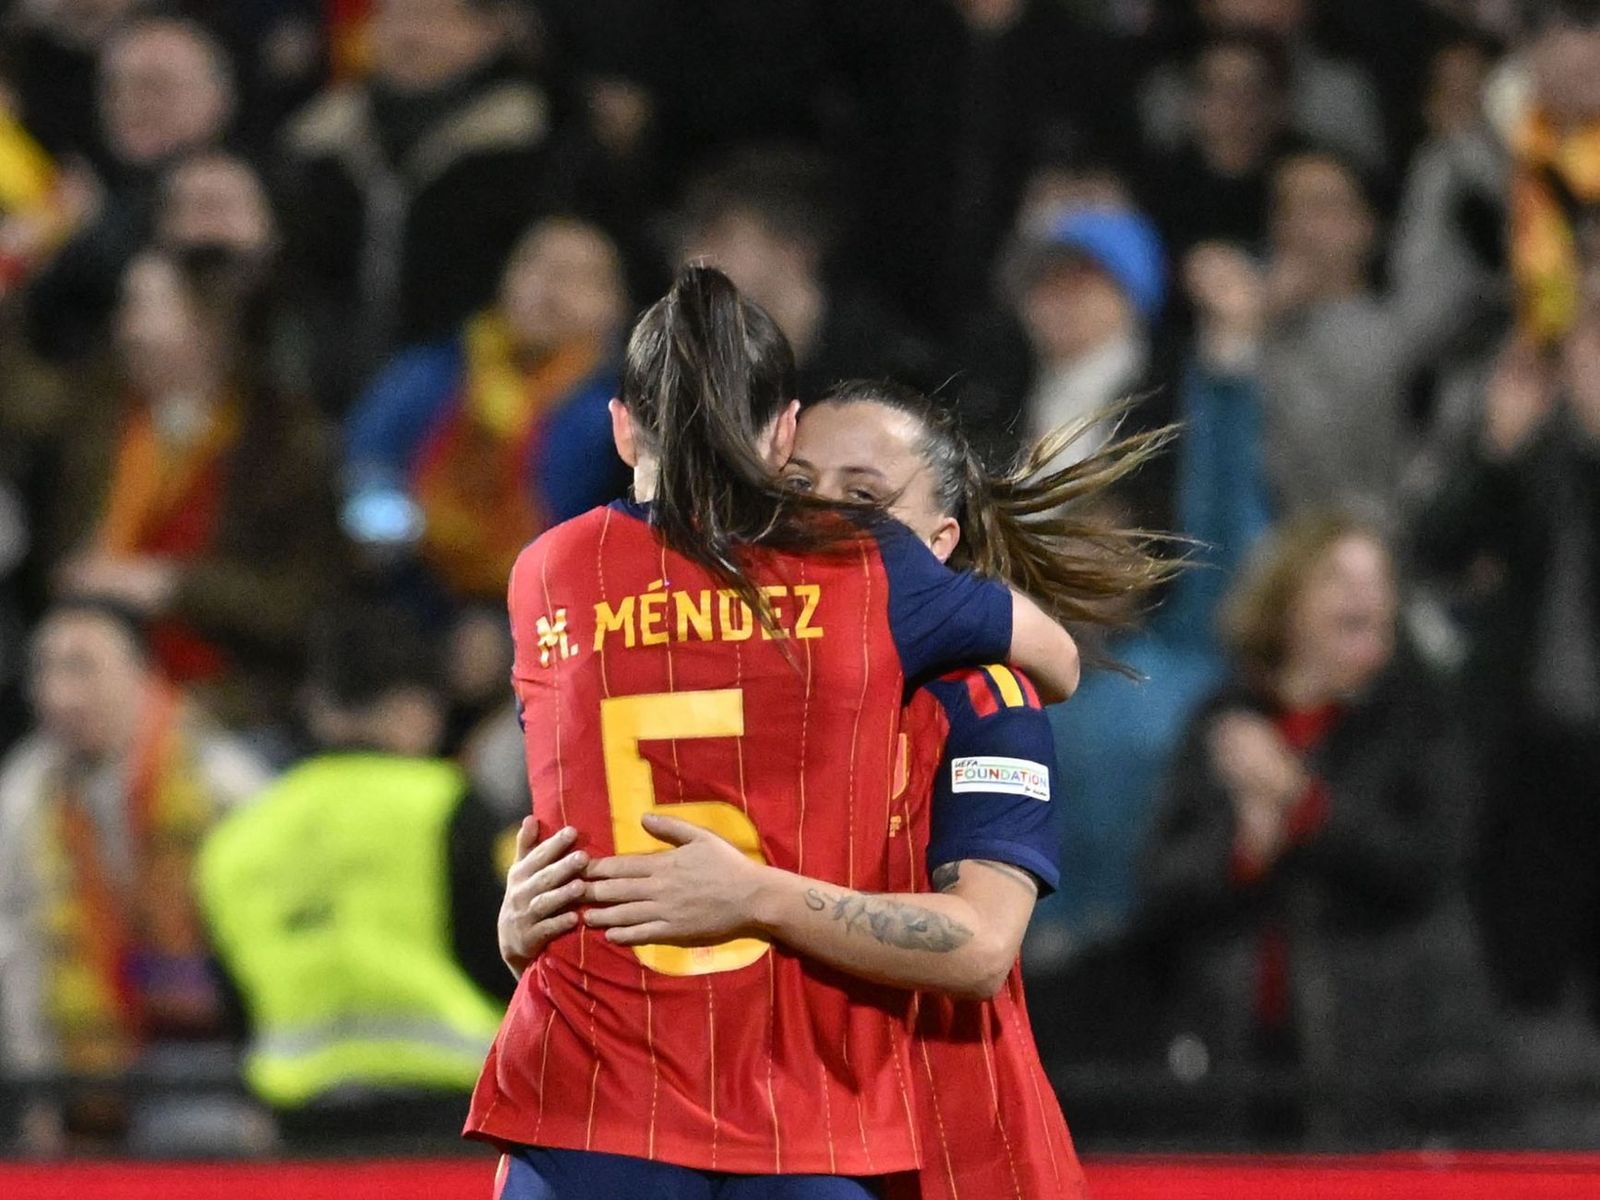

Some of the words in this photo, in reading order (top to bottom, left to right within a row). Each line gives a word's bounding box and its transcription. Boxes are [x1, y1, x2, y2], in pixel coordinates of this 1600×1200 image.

[535, 608, 579, 668] M.
[593, 579, 825, 652] MÉNDEZ
[954, 767, 1048, 788] FOUNDATION
[601, 688, 771, 977] 5
